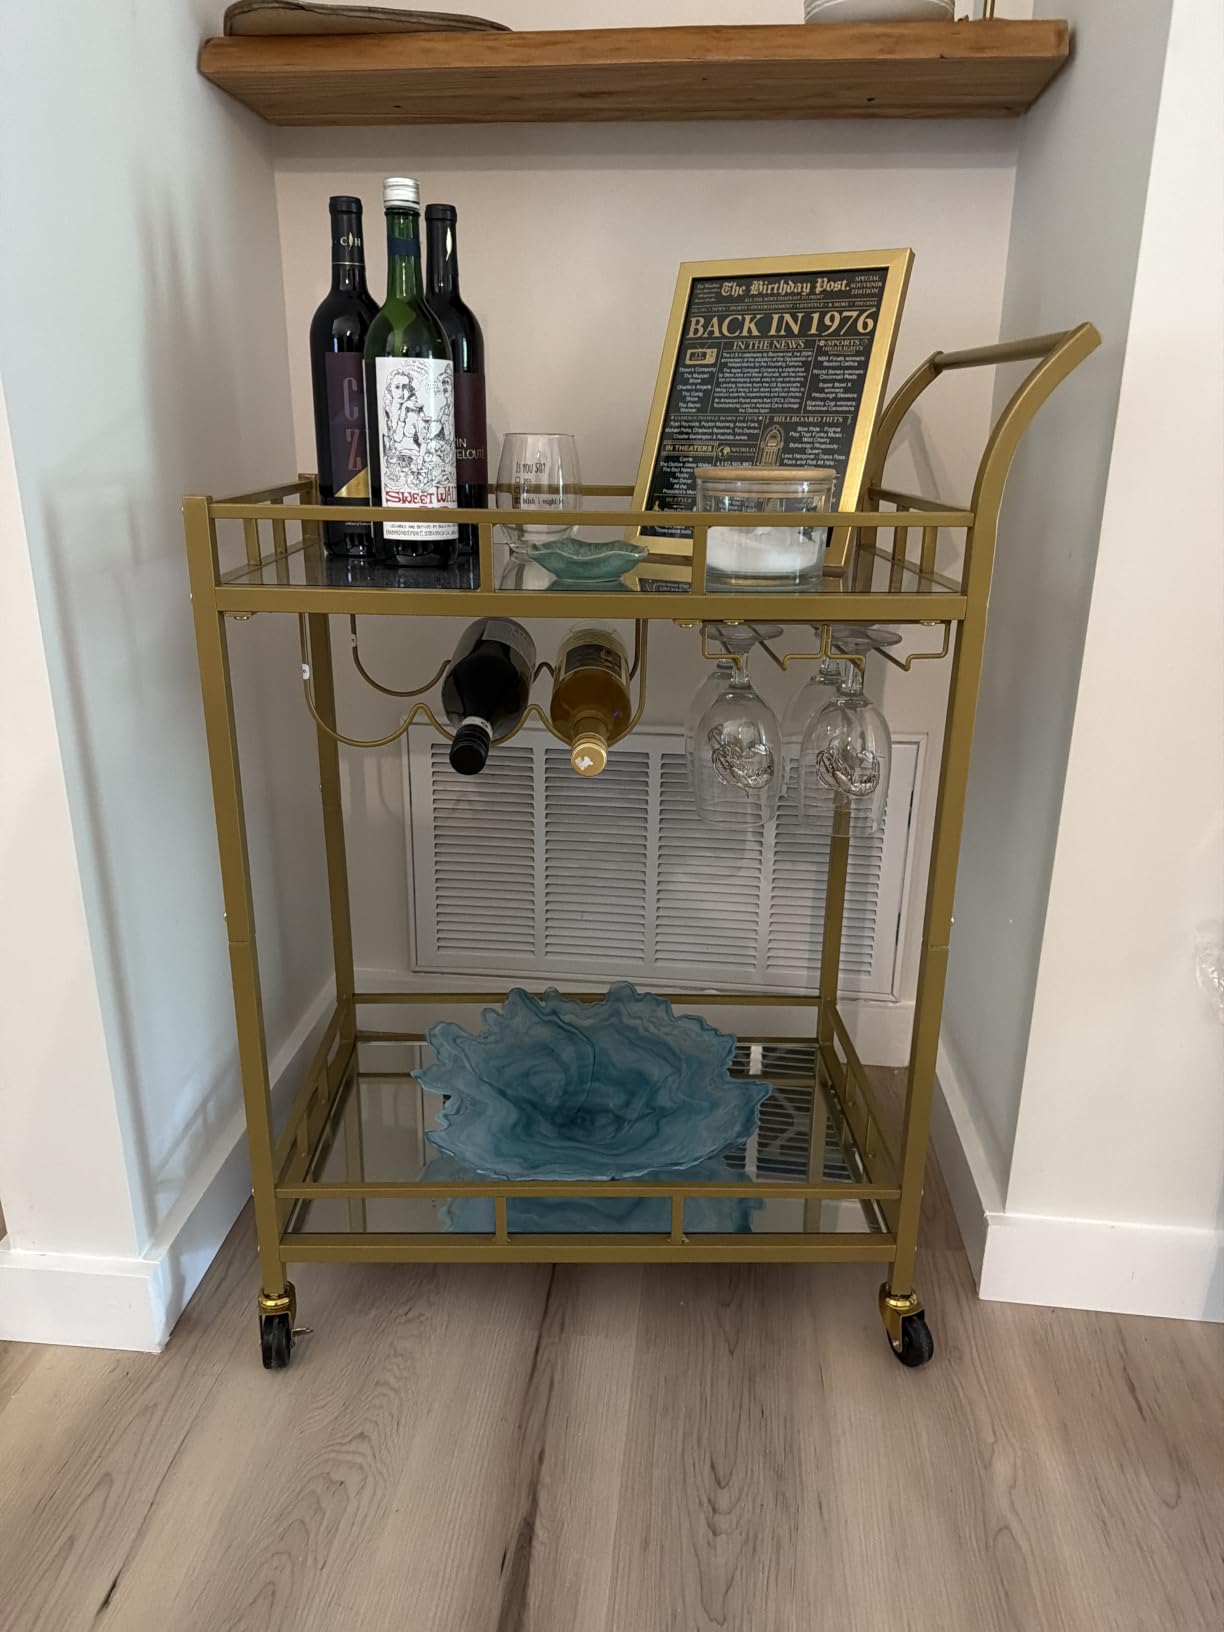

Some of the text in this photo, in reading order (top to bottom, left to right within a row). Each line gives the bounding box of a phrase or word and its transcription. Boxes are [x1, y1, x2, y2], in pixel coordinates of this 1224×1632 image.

[721, 277, 850, 297] The Birthday Post.
[686, 307, 876, 338] BACK IN 1976
[733, 339, 805, 350] IN THE NEWS
[455, 438, 467, 448] IN
[385, 490, 435, 504] SWEET
